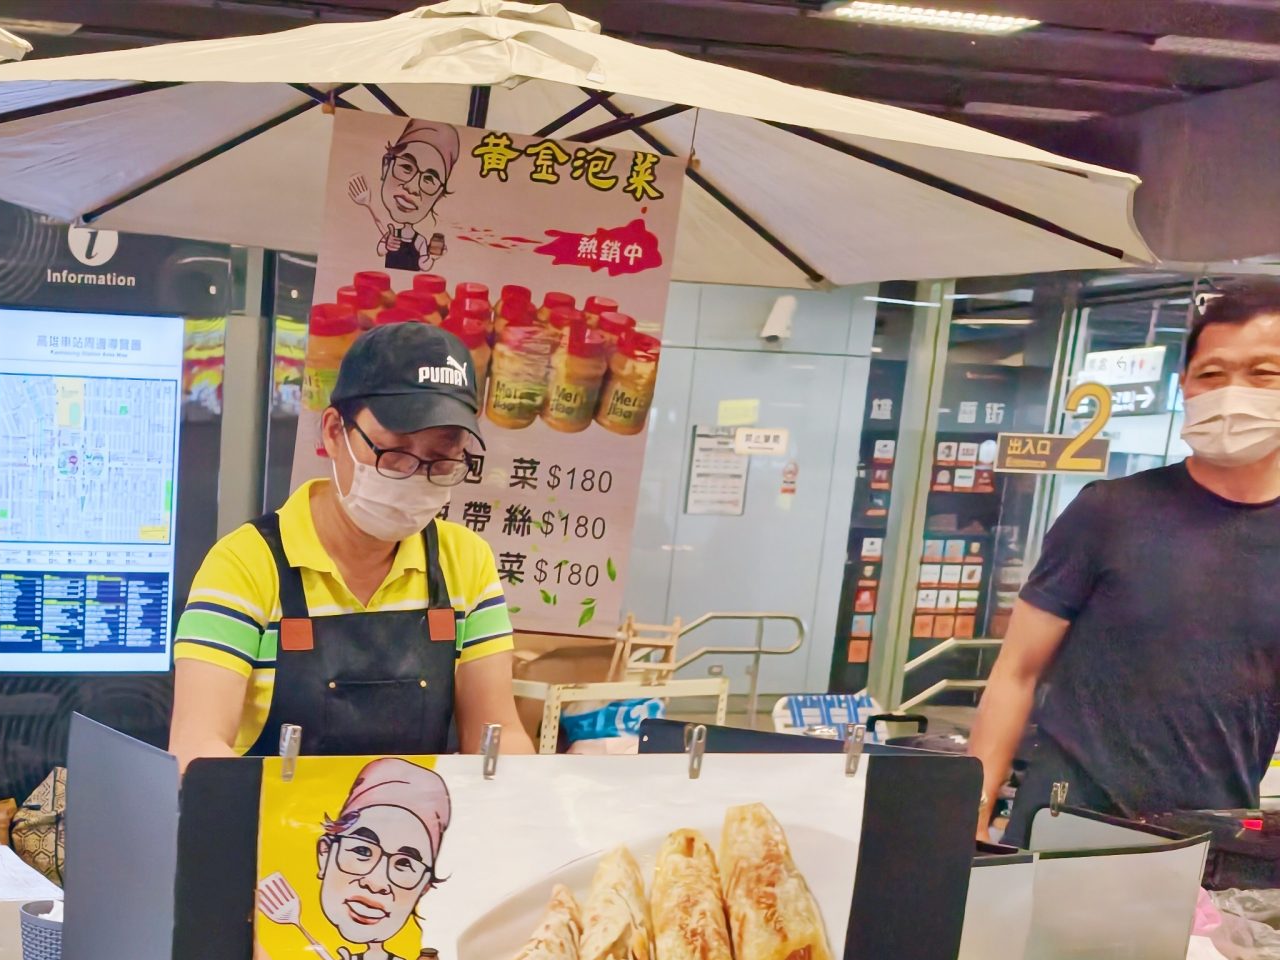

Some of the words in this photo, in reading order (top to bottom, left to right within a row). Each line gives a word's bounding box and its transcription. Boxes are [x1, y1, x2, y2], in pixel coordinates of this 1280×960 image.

[577, 237, 643, 266] 熱銷中
[47, 269, 136, 287] Information
[418, 366, 464, 386] PUMA
[1056, 383, 1112, 470] 2
[1007, 438, 1051, 455] 出入口
[547, 464, 612, 494] $180
[435, 501, 533, 537] 帶絲
[540, 510, 606, 540] $180
[534, 558, 599, 587] $180
